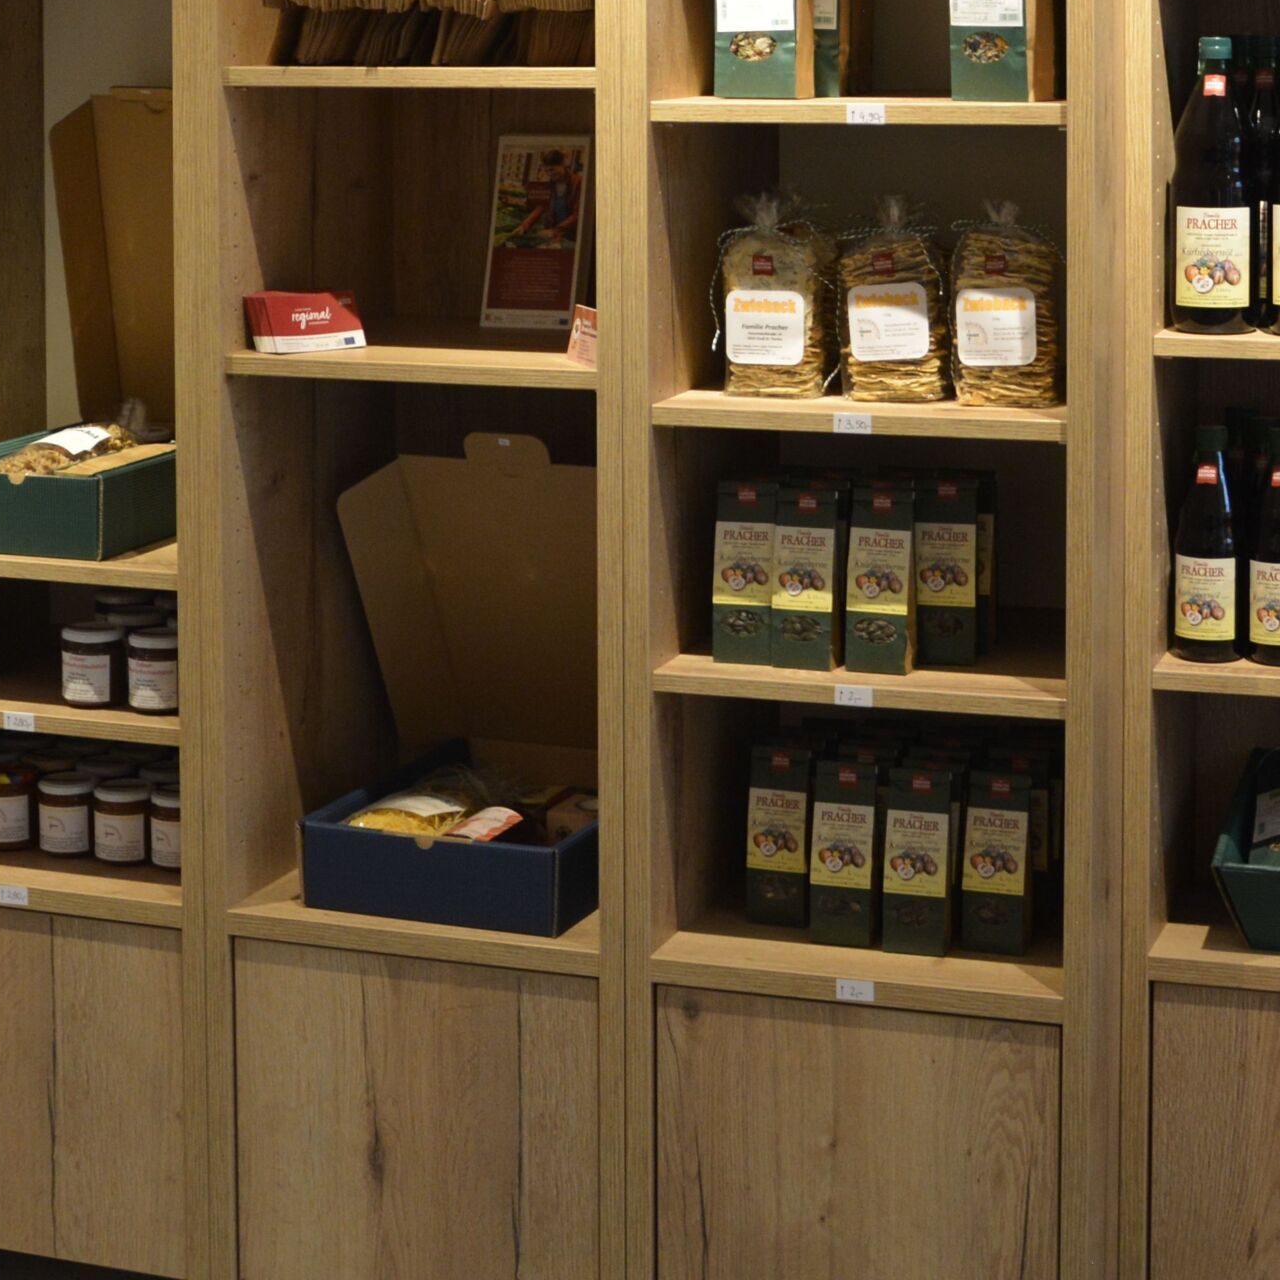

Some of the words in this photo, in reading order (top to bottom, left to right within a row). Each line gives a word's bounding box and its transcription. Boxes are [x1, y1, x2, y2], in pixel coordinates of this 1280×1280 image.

[1186, 218, 1238, 229] PRACHER
[291, 306, 332, 330] regional
[723, 530, 769, 541] PRACHER
[781, 534, 827, 548] PRACHER
[858, 536, 905, 549] PRACHER
[921, 529, 969, 542] PRACHER
[1181, 565, 1225, 578] PRACHER
[756, 796, 800, 810] PRACHER
[821, 810, 867, 824] PRACHER
[892, 817, 940, 831] PRACHER
[972, 815, 1020, 830] PRACHER
